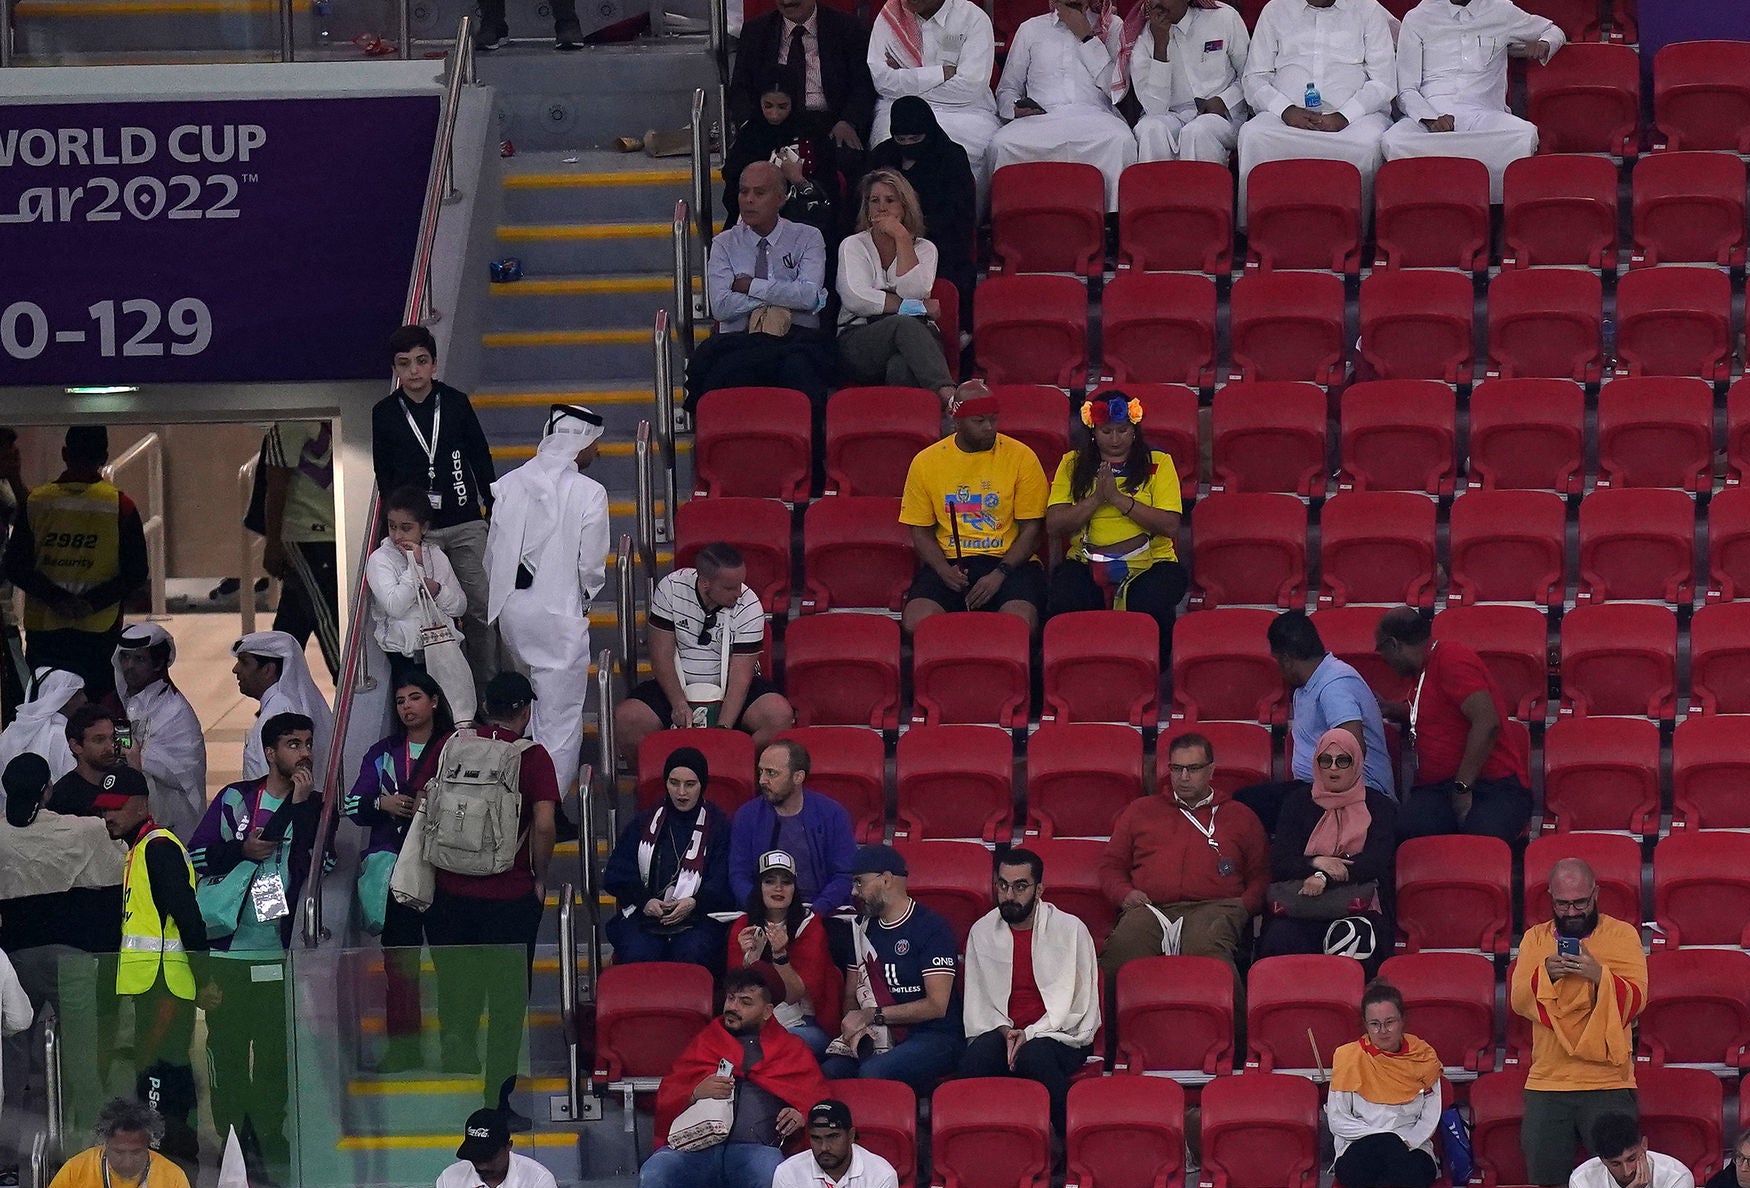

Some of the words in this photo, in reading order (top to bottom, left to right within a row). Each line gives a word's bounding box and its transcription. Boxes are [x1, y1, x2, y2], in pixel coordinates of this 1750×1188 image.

[168, 125, 267, 163] CUP
[451, 449, 467, 506] adidas
[44, 532, 98, 549] 2982
[948, 535, 1004, 550] Euador
[932, 956, 955, 967] QNB
